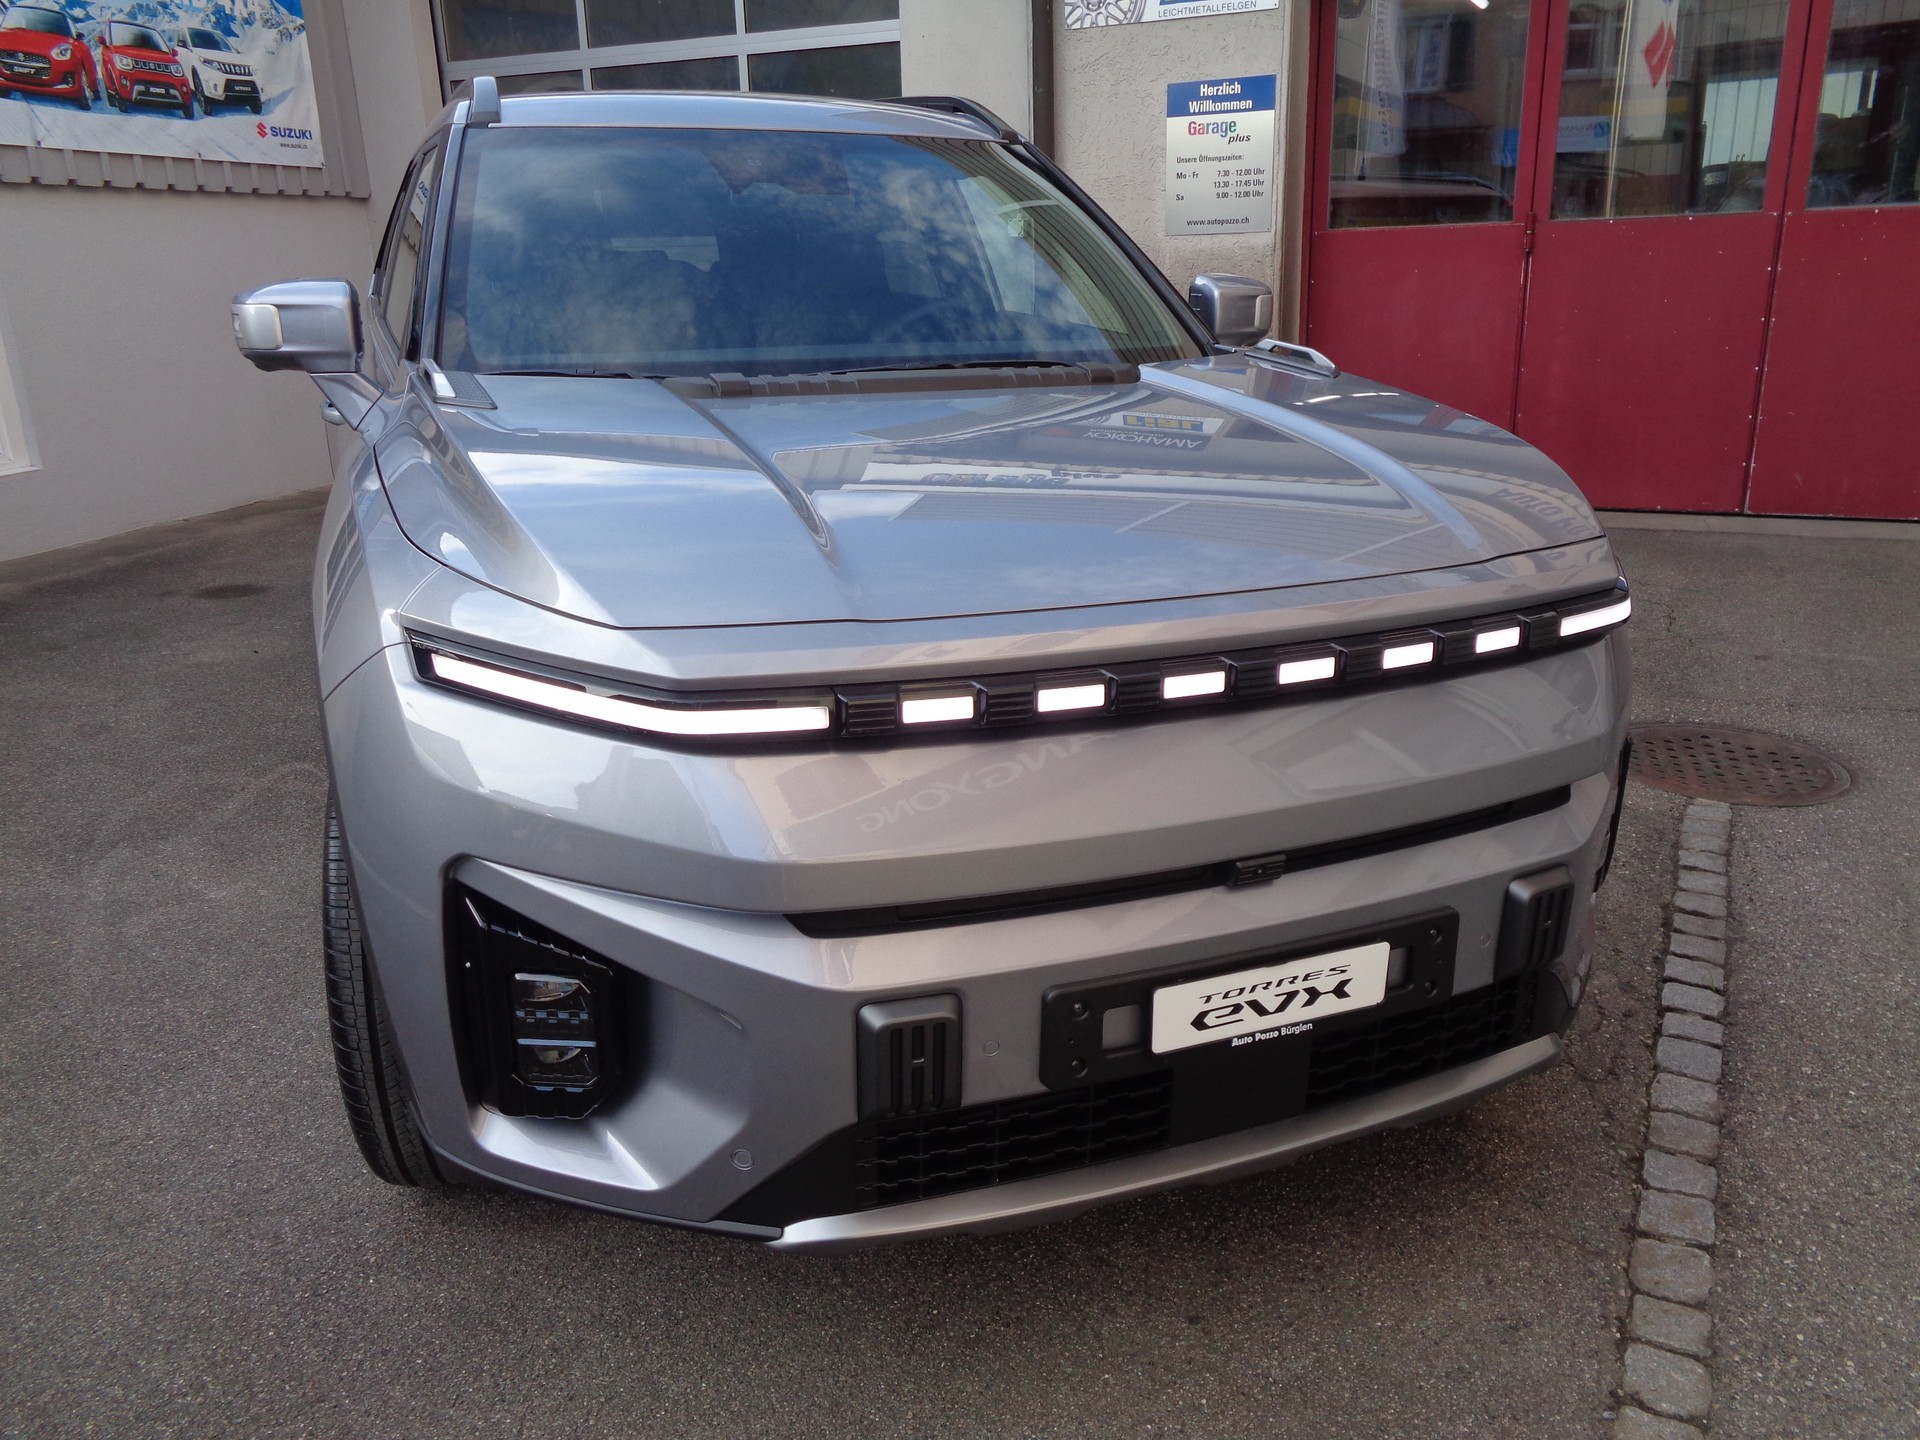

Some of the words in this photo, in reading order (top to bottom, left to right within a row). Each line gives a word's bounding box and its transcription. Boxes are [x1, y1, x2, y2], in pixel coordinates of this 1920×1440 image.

[1158, 0, 1257, 18] LEICHTMETALLFELGEN
[1200, 81, 1241, 97] Herzlich
[1189, 100, 1252, 113] Willkommen
[269, 126, 313, 140] SUZUKI
[1188, 120, 1237, 138] Garage
[1227, 133, 1251, 145] plus
[1176, 156, 1197, 164] Unsere
[1199, 154, 1245, 163] Öffnungszeiten:
[1176, 172, 1187, 180] Mo
[1192, 171, 1199, 179] Fr
[1217, 169, 1230, 177] 7.30
[1235, 168, 1252, 177] 12.00
[1253, 168, 1265, 176] Uhr
[1213, 181, 1230, 189] 13.30
[1235, 180, 1252, 188] 17.45
[1252, 179, 1265, 187] Uhr
[1175, 193, 1185, 201] Sa
[1216, 191, 1229, 199] 9.00
[1234, 190, 1251, 199] 12.00
[1252, 190, 1264, 198] Uhr
[1186, 216, 1250, 227] www.autopozzo.ch
[1199, 964, 1352, 1005] TORRES
[1231, 1035, 1254, 1047] Auto
[1255, 1029, 1280, 1042] Pozzo
